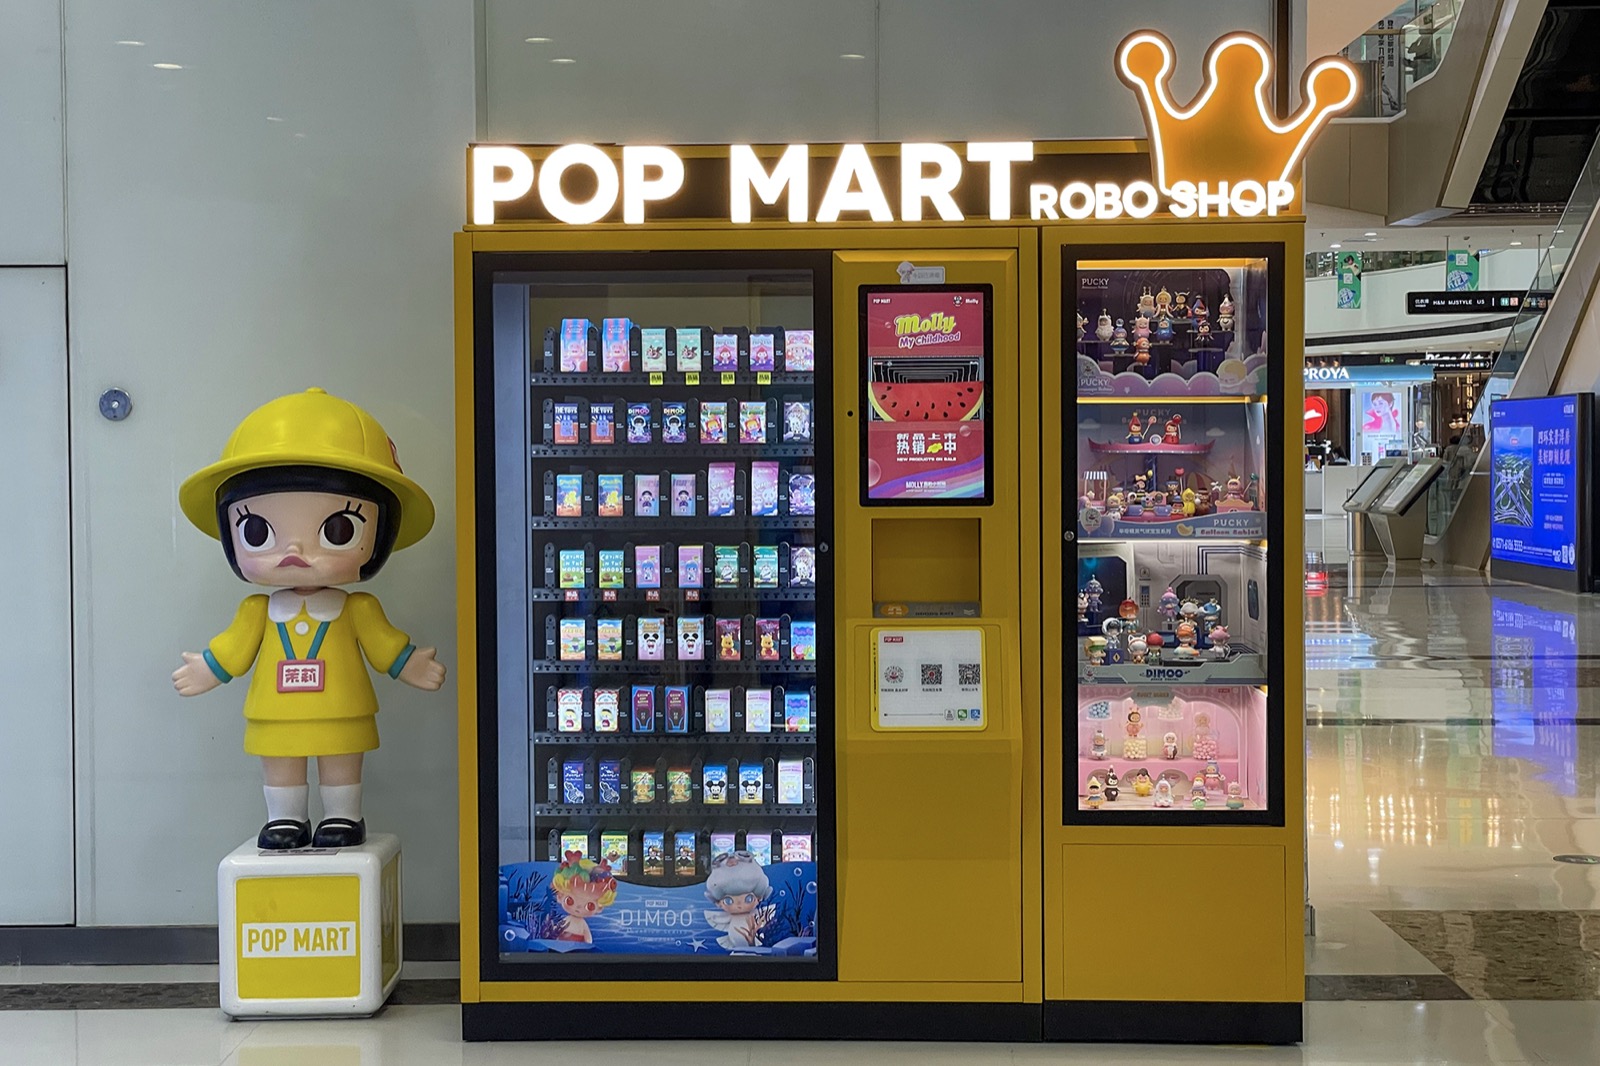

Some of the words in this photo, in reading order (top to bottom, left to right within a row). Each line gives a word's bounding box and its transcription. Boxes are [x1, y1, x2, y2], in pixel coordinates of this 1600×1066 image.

[472, 144, 685, 225] POP
[729, 142, 1033, 224] MART
[1030, 182, 1158, 220] ROBO
[1167, 180, 1296, 218] SHOP
[1081, 278, 1109, 286] PUCKY
[895, 312, 957, 335] Molly
[898, 336, 915, 349] My
[915, 331, 961, 345] Childhood
[1213, 518, 1250, 527] PUCKY
[284, 668, 317, 684] 茉莉
[1146, 669, 1184, 678] DIMOO
[620, 909, 692, 927] DIMOO
[247, 927, 287, 952] POP
[293, 926, 351, 951] MART
